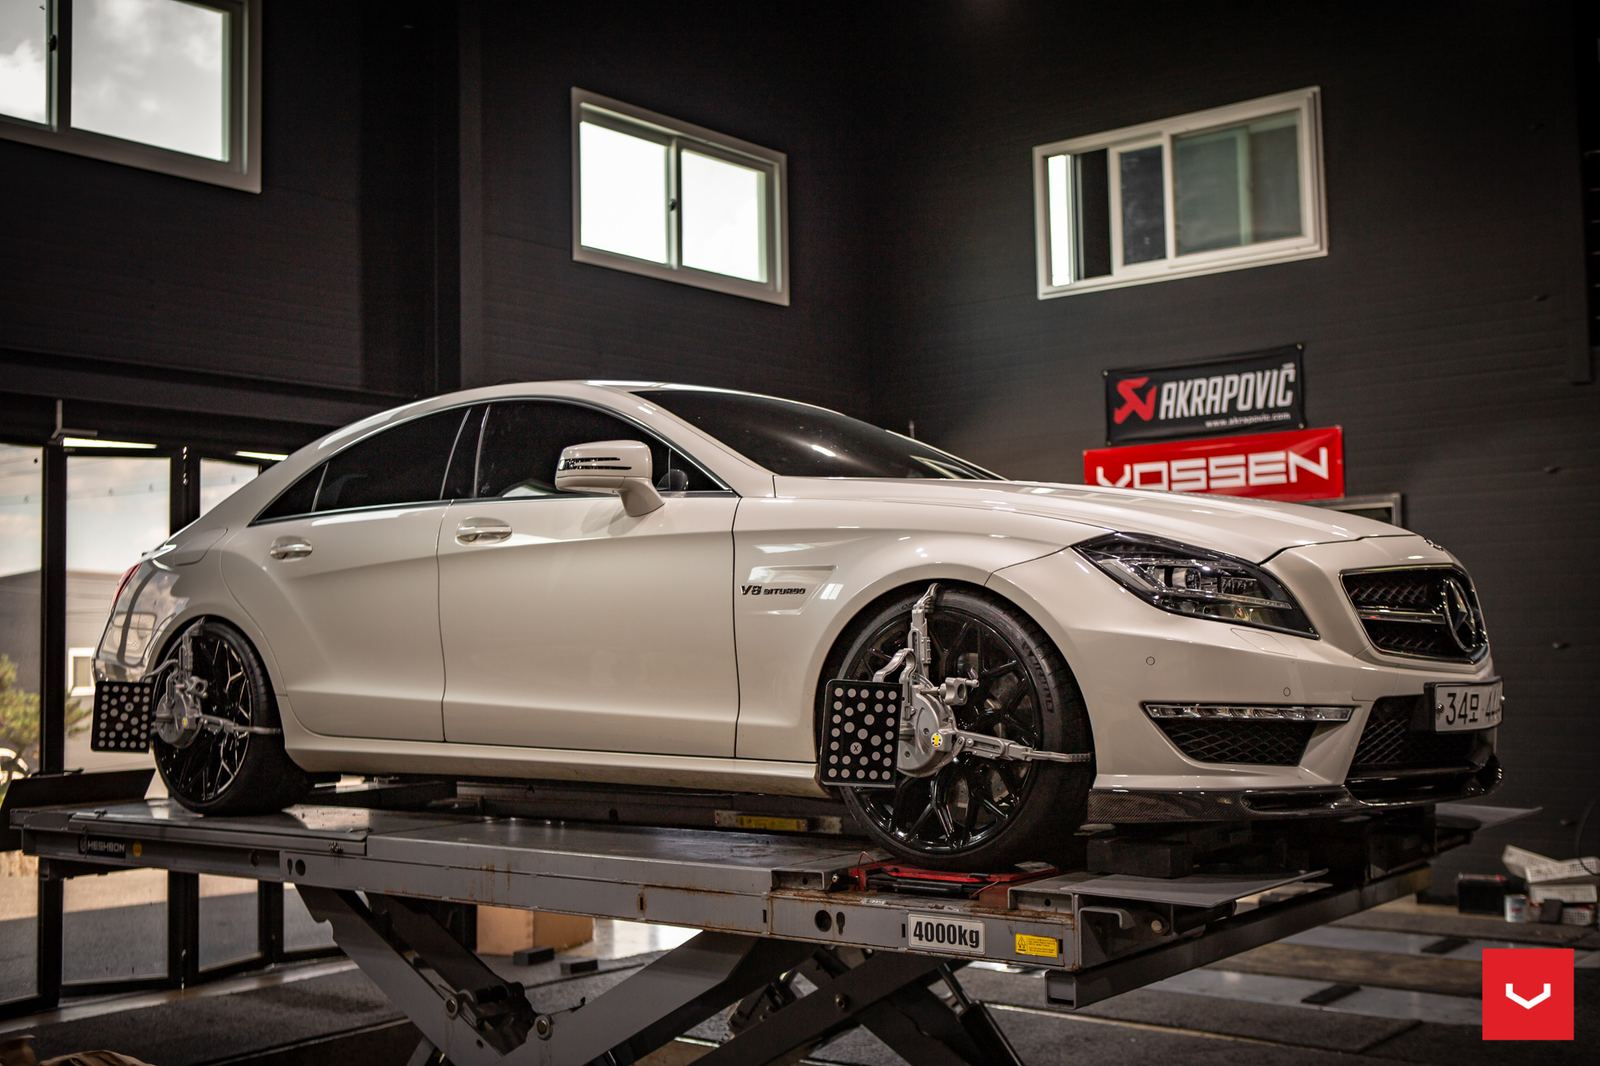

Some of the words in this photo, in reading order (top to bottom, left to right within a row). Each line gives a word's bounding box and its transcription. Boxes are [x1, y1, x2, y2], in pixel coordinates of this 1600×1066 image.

[1096, 447, 1329, 491] VOSSEN
[741, 585, 762, 595] V8
[913, 920, 980, 949] 4000kg
